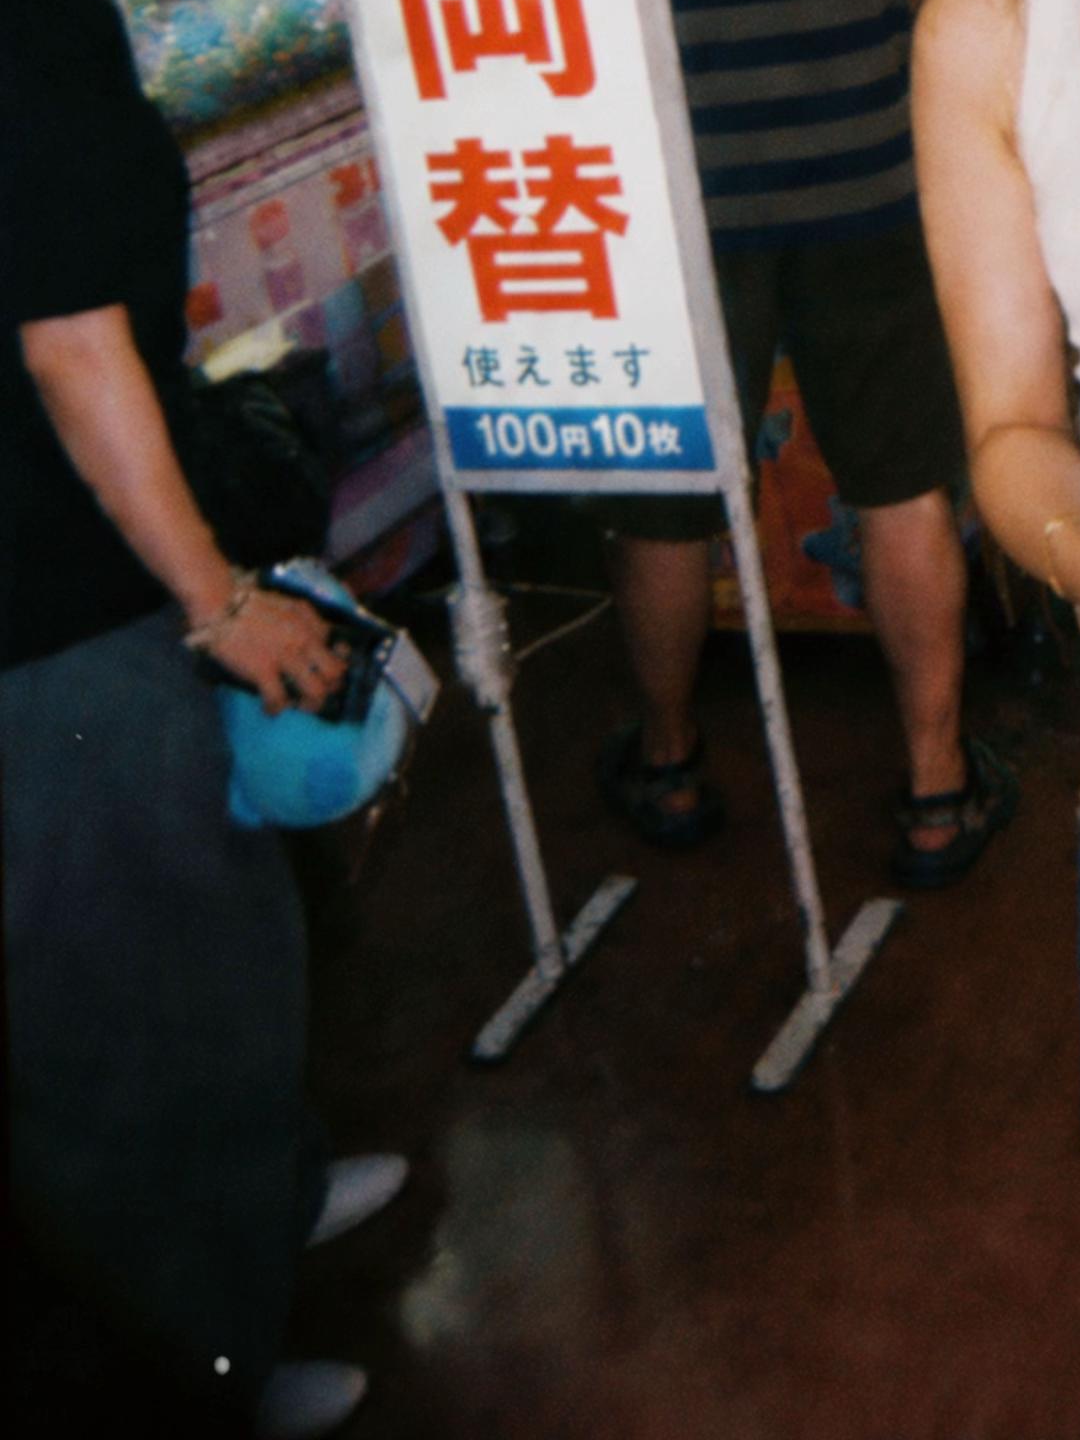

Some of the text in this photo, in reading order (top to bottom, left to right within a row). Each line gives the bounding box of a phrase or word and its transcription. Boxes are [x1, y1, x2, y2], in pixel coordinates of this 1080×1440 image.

[462, 343, 650, 389] 使えます
[476, 413, 682, 457] 100円10枚
